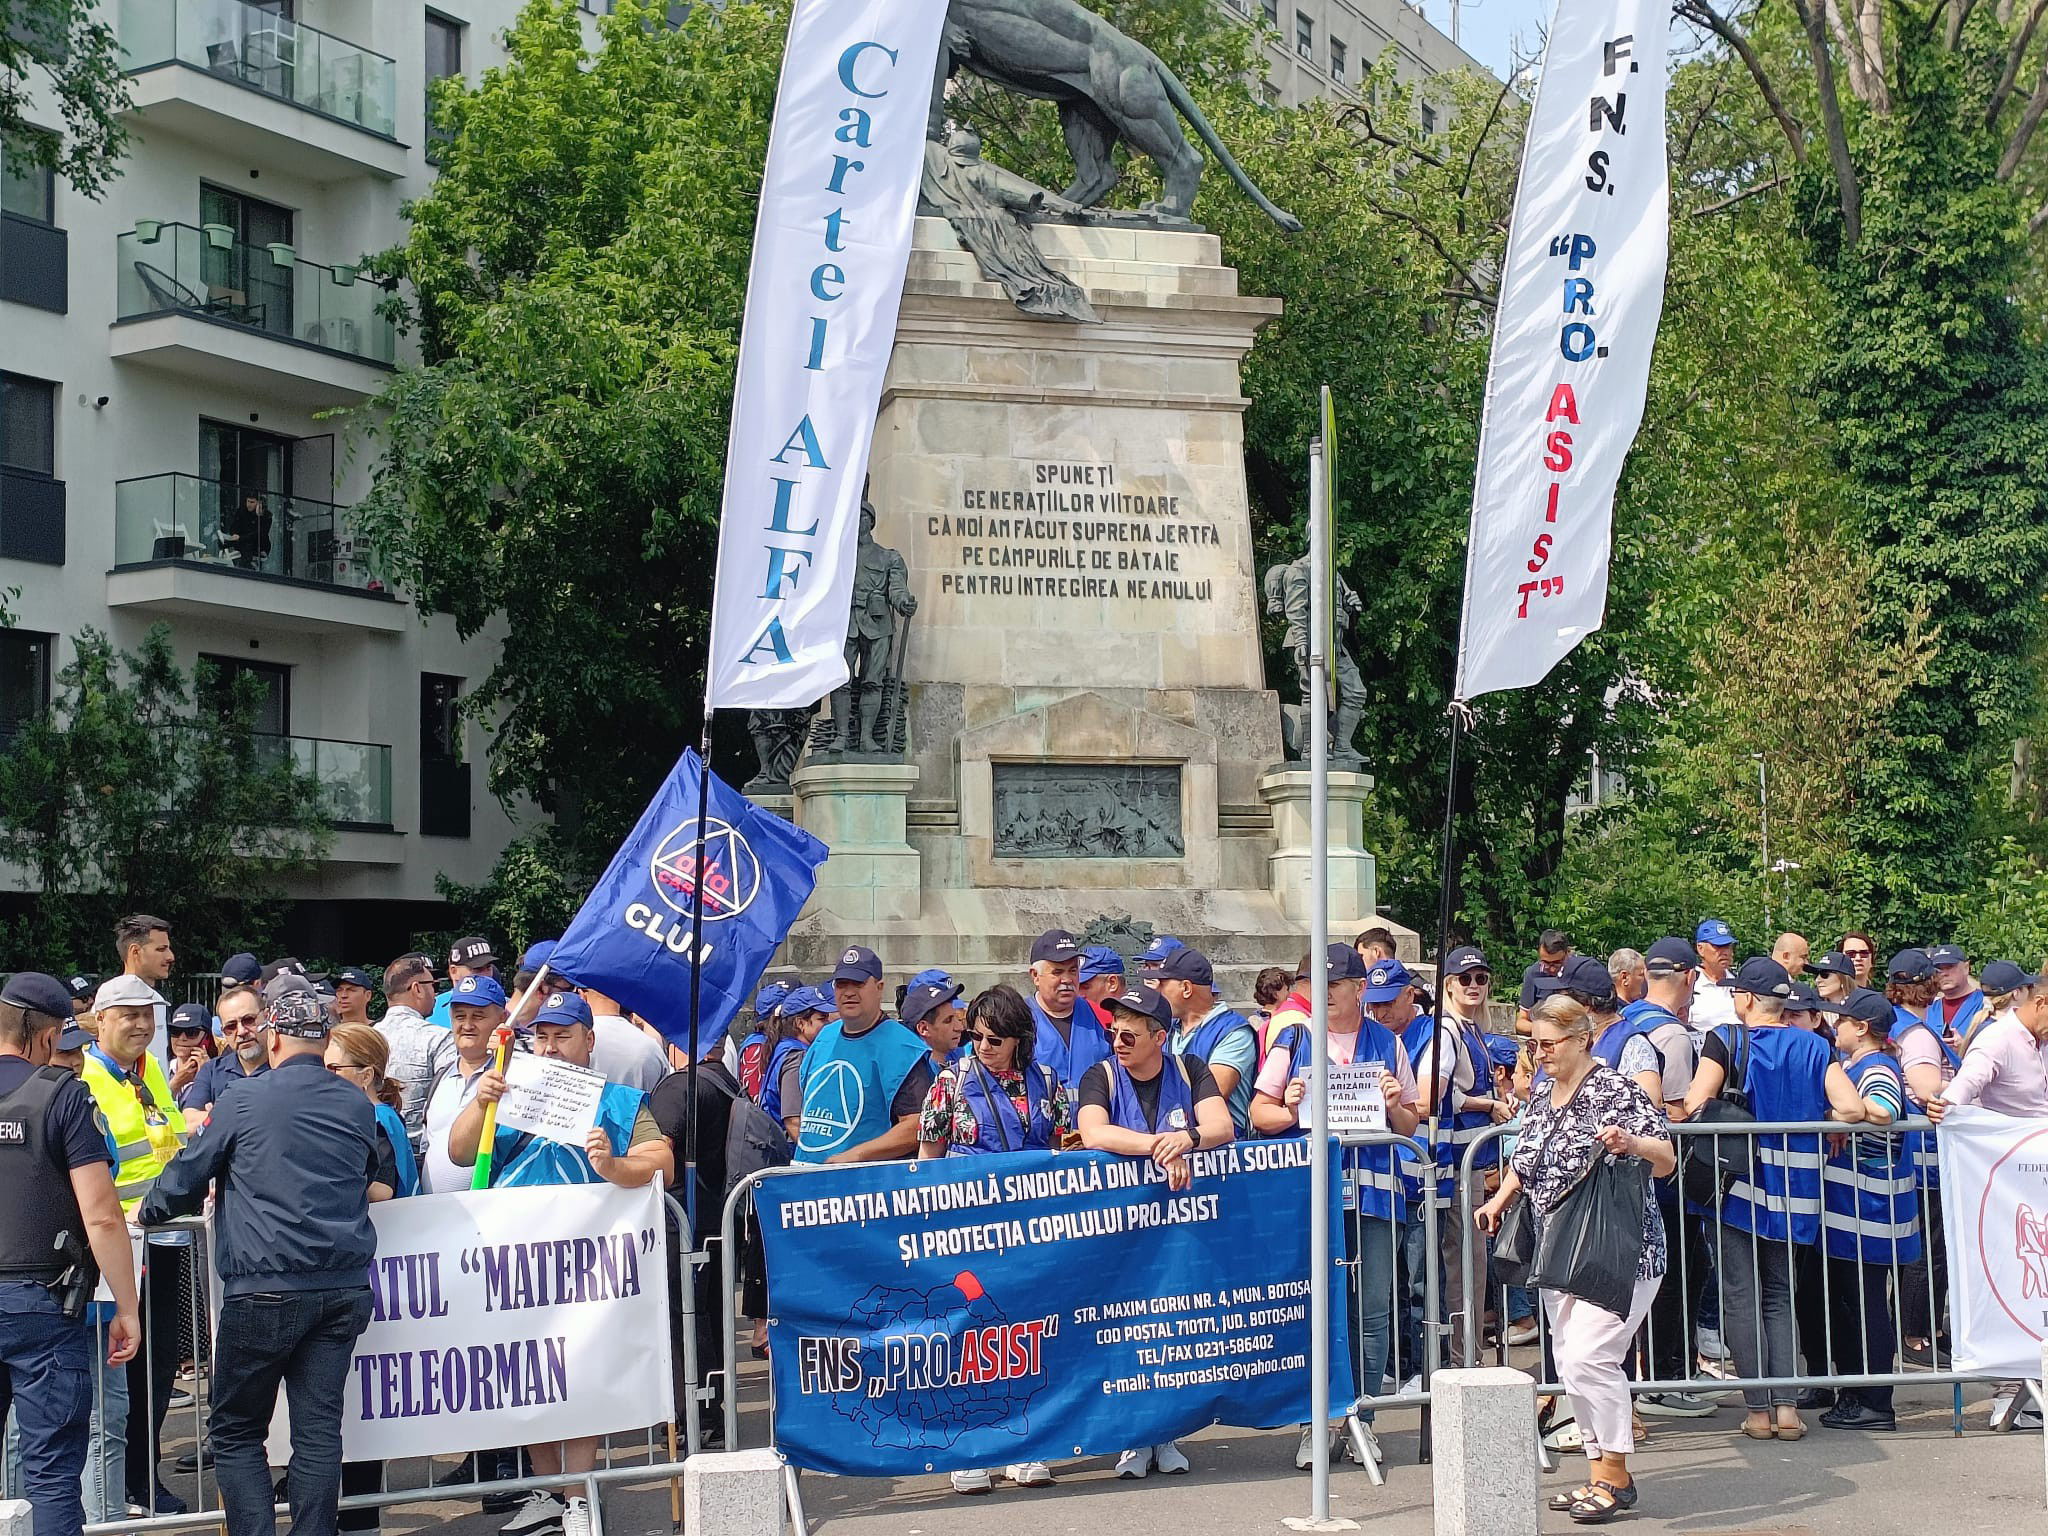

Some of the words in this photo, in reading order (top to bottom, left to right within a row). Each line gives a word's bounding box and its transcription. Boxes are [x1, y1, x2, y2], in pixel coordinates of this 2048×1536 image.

[803, 41, 899, 371] Cartel
[1099, 493, 1179, 516] VIITOARE
[738, 413, 831, 666] ALFA
[956, 515, 983, 538] NOI
[988, 519, 1010, 539] AM
[1072, 521, 1152, 543] SUPREMA
[962, 546, 984, 567] PE
[1091, 550, 1112, 569] DE
[942, 575, 1014, 595] PENTRU
[1127, 578, 1212, 601] NEAMULUI
[780, 1193, 889, 1228] FEDERAȚIA
[891, 1173, 1001, 1220] NAȚIONALĂ
[1004, 1161, 1103, 1202] SINDICALĂ
[1105, 1162, 1139, 1189] DIN
[898, 1233, 918, 1268] ȘI
[922, 1220, 1026, 1258] PROTECȚIA
[1028, 1207, 1123, 1243] COPILULUI
[1126, 1194, 1219, 1231] PRO.ASIST
[1074, 1305, 1101, 1324] STR.
[1103, 1299, 1147, 1319] MAXIM
[1150, 1295, 1190, 1313] GORKI
[1193, 1293, 1216, 1310] NR.
[1218, 1291, 1231, 1309] 4,
[1232, 1287, 1265, 1305] MUN.
[1096, 1328, 1121, 1345] COD
[1124, 1321, 1174, 1343] POȘTAL
[1222, 1313, 1247, 1331] JUD.
[1250, 1304, 1305, 1327] BOTOȘANI
[798, 1336, 862, 1394] FNS
[1137, 1344, 1192, 1366] TEL/FAX
[1195, 1333, 1274, 1357] 0231-586402
[354, 1336, 568, 1420] TELEORMAN
